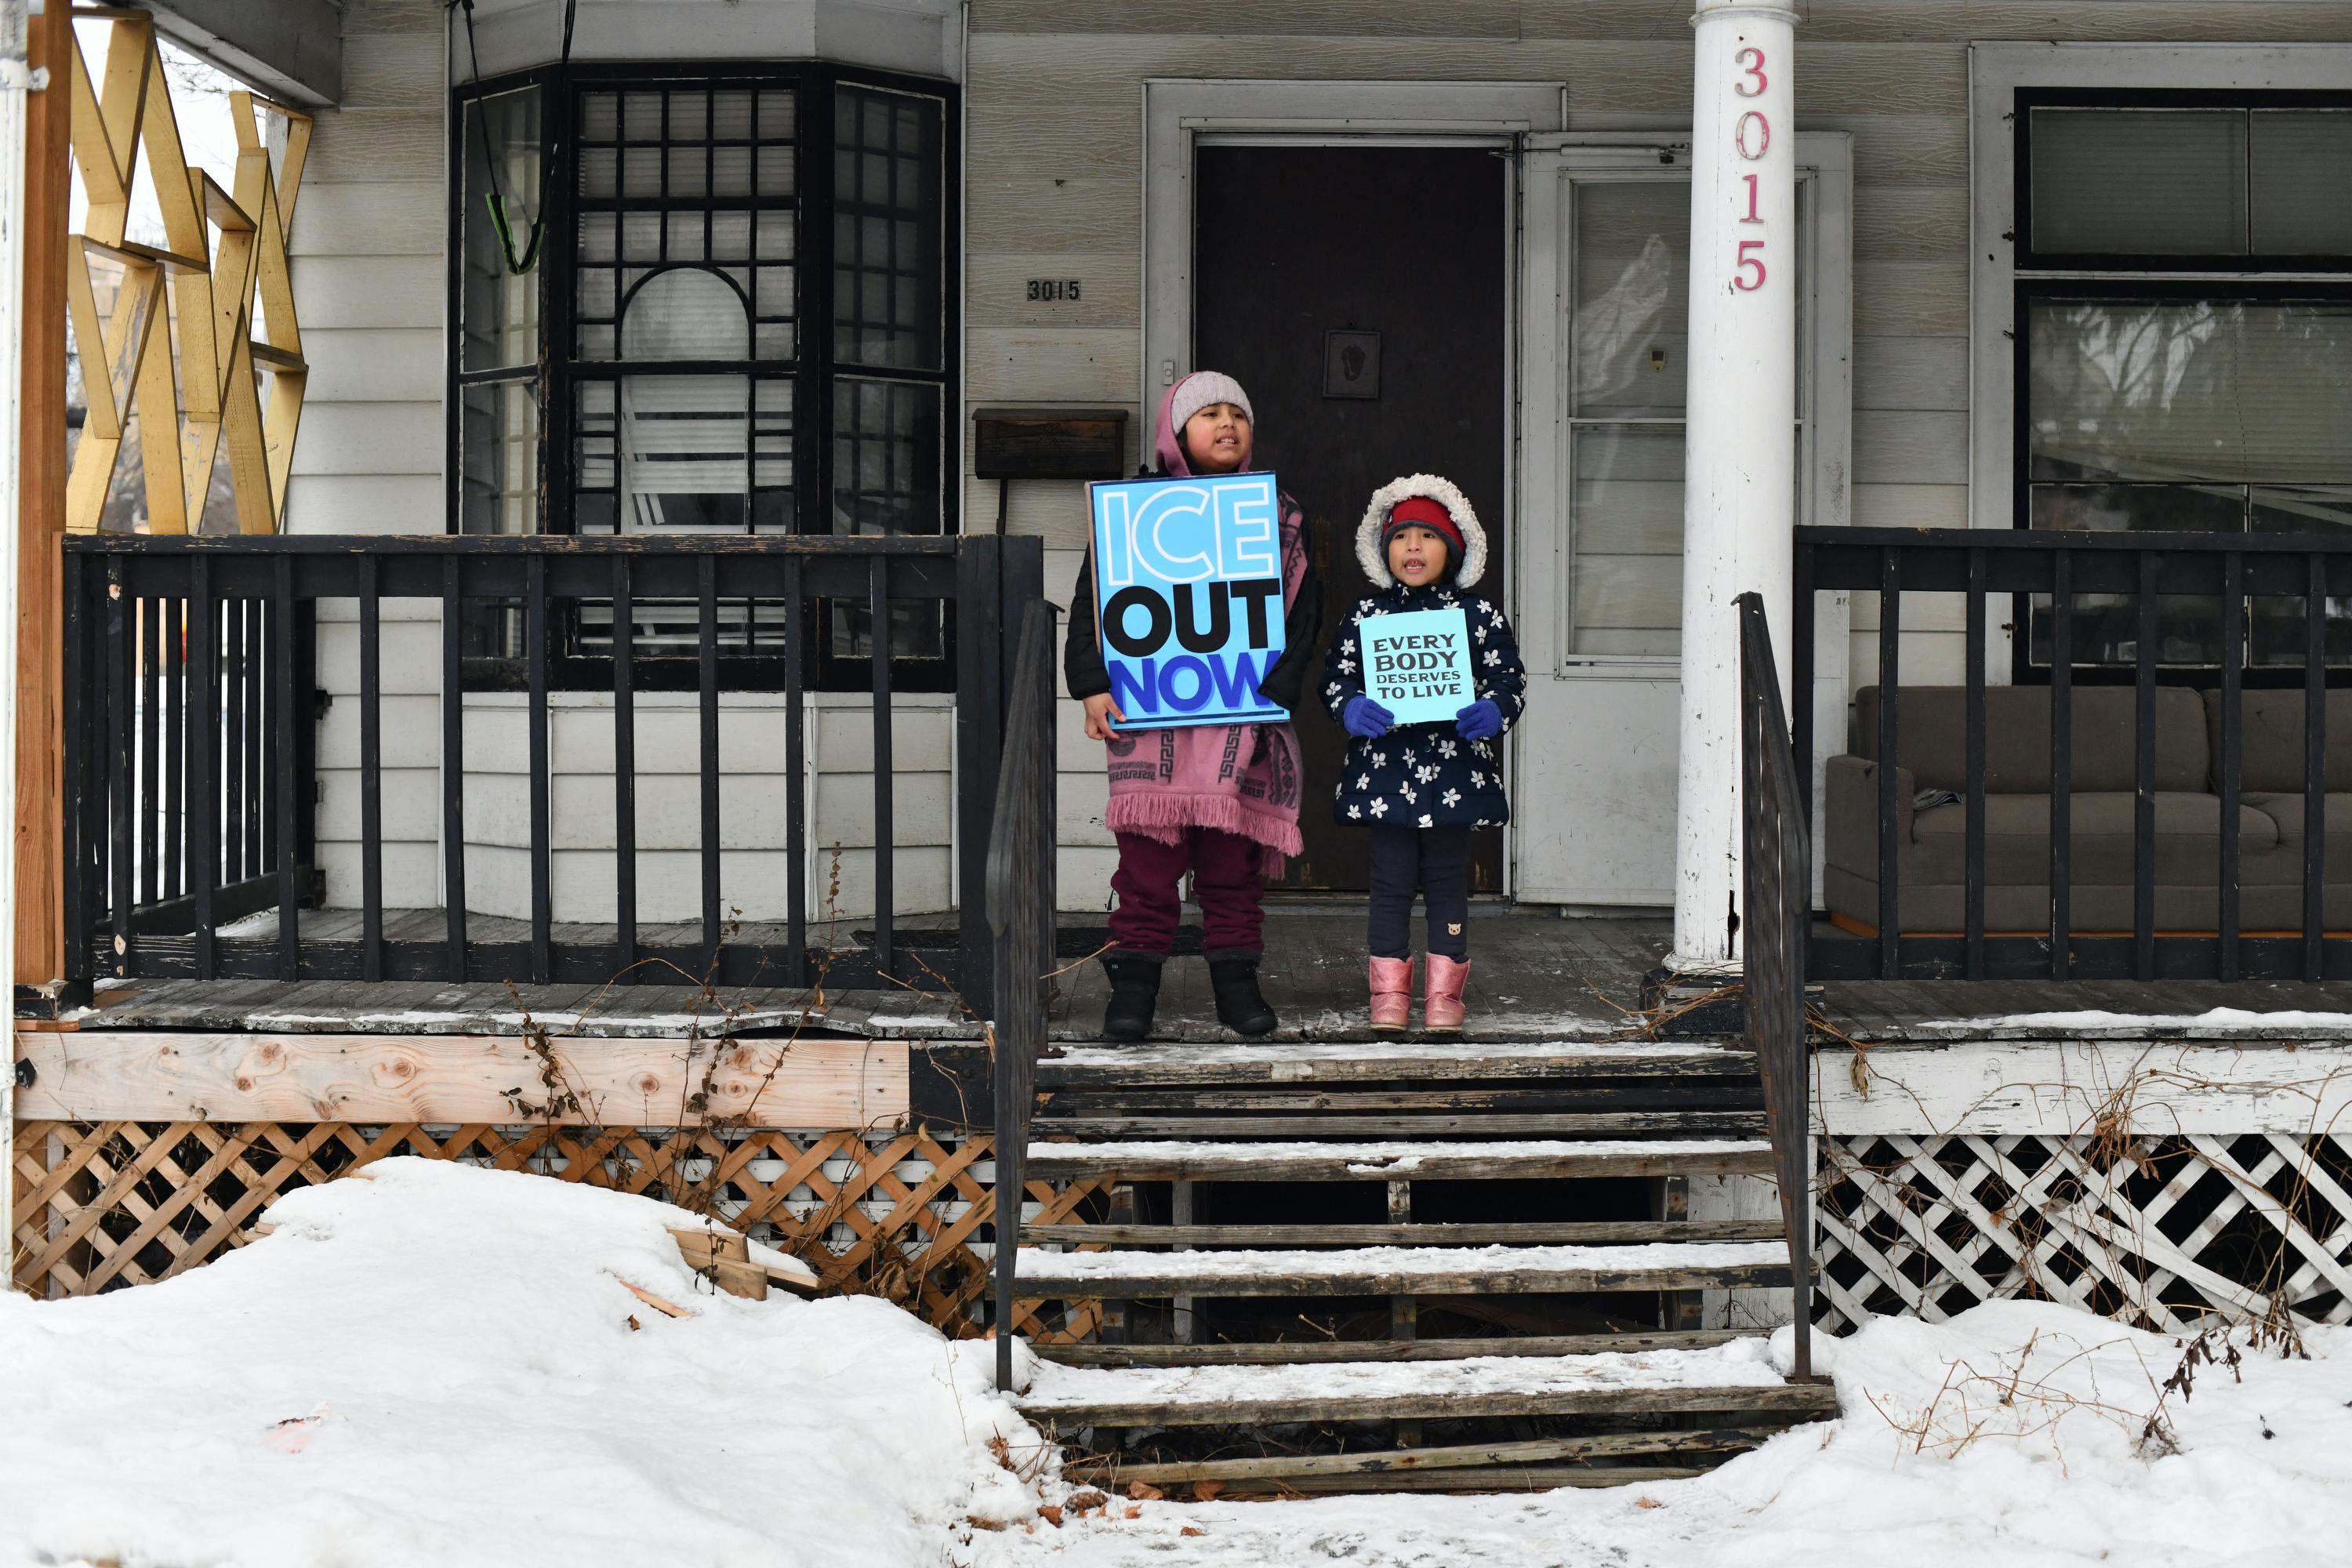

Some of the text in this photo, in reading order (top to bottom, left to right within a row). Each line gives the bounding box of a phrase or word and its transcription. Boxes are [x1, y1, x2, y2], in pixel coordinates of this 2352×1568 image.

[1734, 47, 1770, 291] 3015
[1029, 281, 1079, 300] 3015
[1103, 482, 1274, 586] ICE
[1102, 578, 1281, 658] OUT
[1373, 633, 1456, 653] EVERY
[1374, 651, 1458, 672] BODY
[1108, 650, 1281, 717] NOW
[1376, 670, 1461, 684] DESERVES
[1377, 684, 1462, 699] TO LIVE
